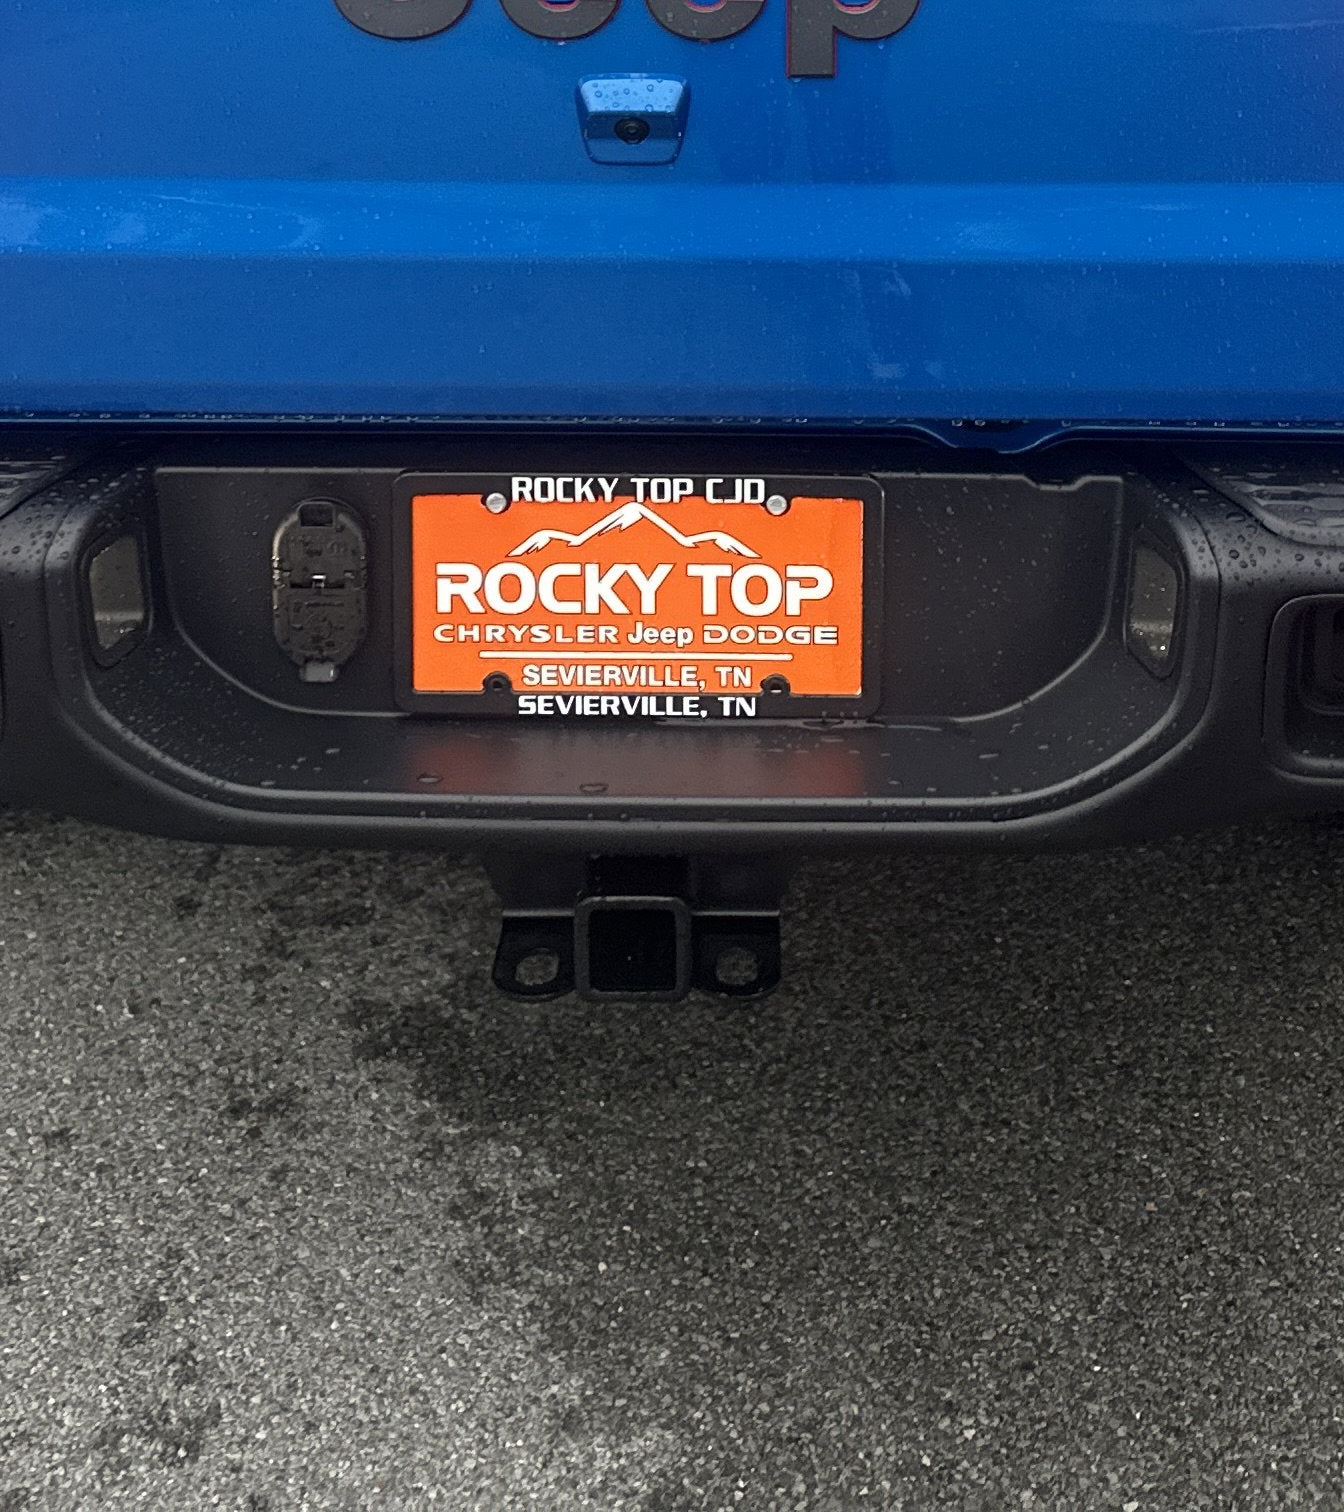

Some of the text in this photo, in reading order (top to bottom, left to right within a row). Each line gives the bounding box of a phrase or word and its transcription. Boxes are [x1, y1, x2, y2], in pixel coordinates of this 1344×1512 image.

[511, 477, 766, 505] ROCKY TOP CJD
[436, 562, 834, 617] ROCKY TOP
[433, 621, 838, 649] CHRYSLER Jeep DODGE
[522, 665, 752, 692] SEVIERVILLE, TN
[518, 695, 756, 718] SEVIERVILLE, TN
